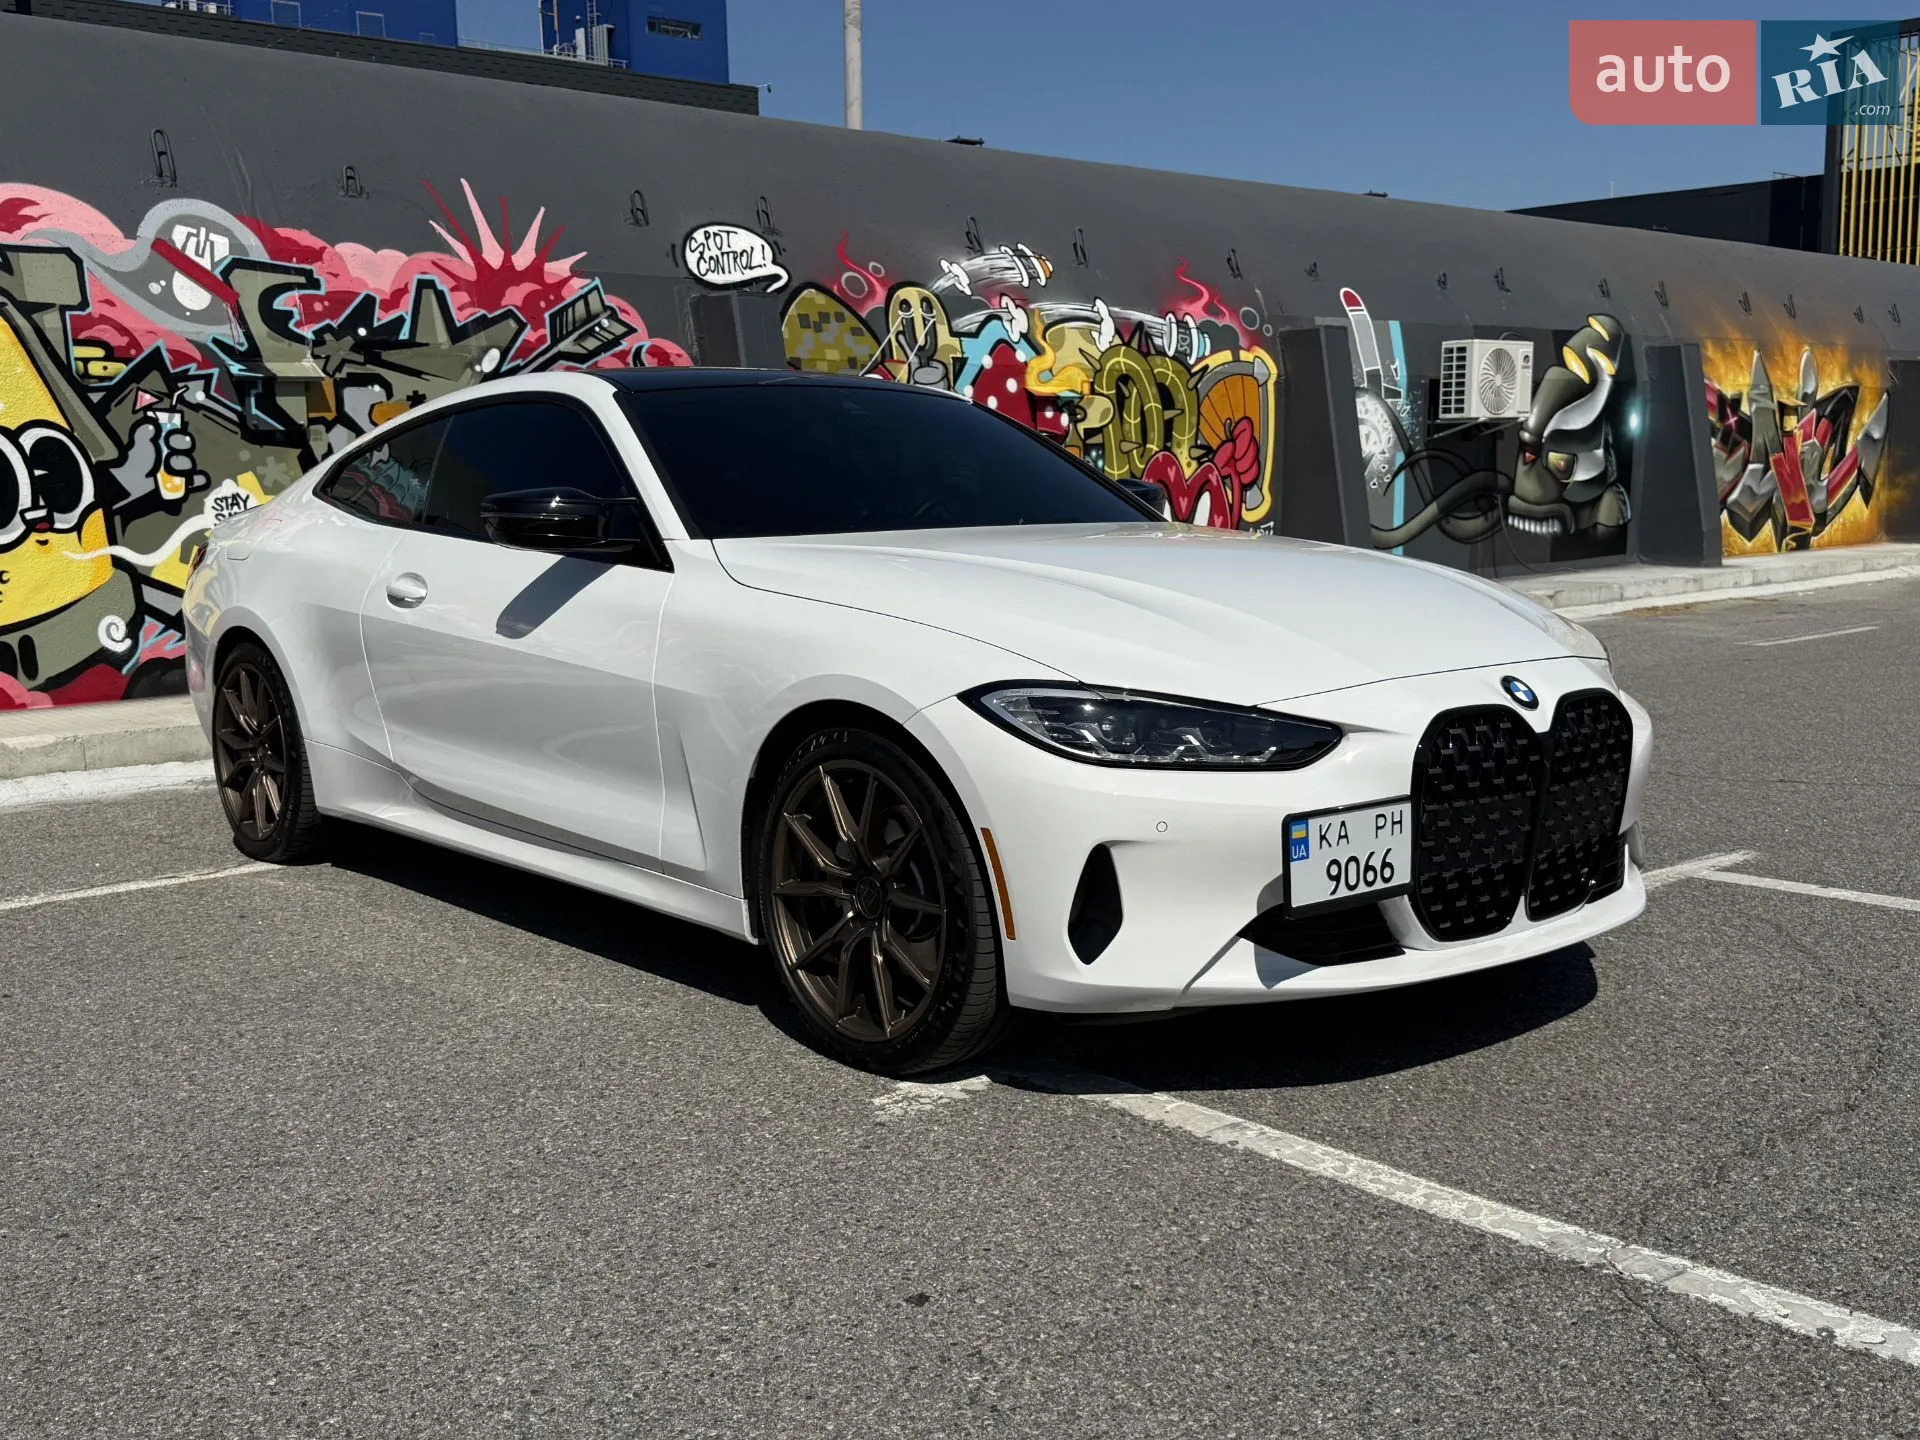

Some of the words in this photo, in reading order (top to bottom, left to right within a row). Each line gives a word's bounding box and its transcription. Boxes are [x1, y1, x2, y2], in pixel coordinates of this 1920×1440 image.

[689, 230, 738, 254] SPOT
[697, 244, 767, 277] CONTROL!
[211, 492, 250, 512] STAY
[1318, 820, 1350, 850] KA
[1374, 809, 1403, 839] PH
[1291, 844, 1307, 859] UA
[1325, 847, 1395, 896] 9066
